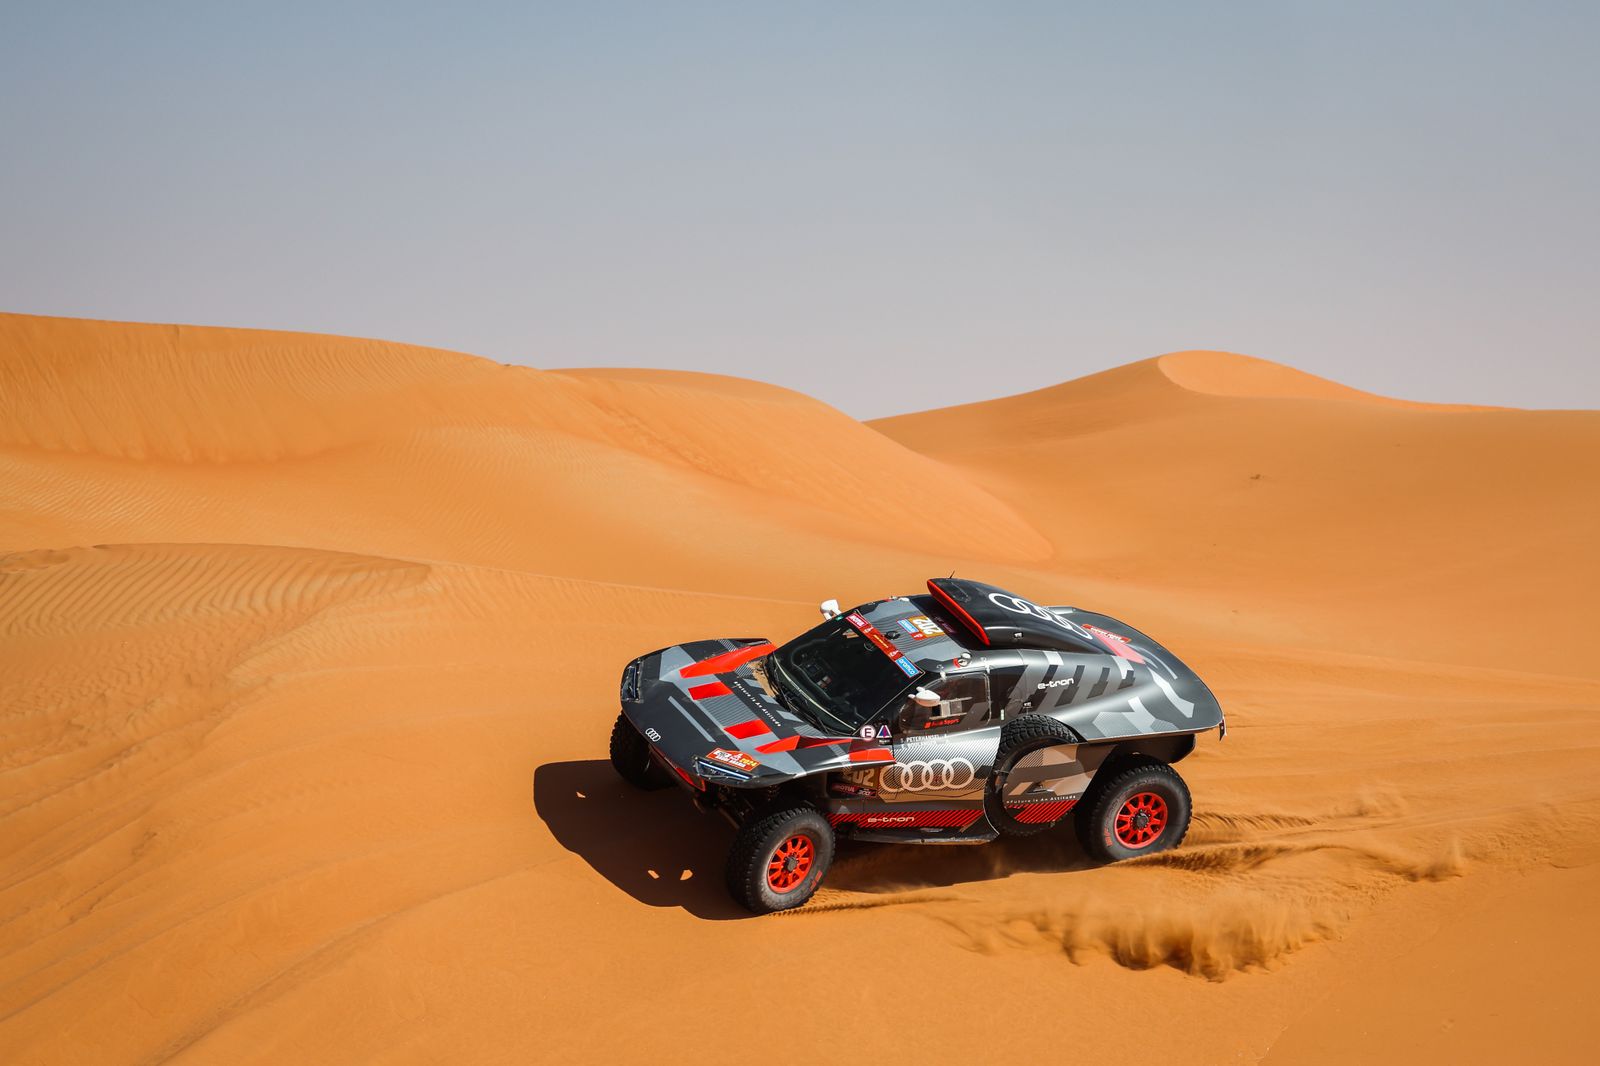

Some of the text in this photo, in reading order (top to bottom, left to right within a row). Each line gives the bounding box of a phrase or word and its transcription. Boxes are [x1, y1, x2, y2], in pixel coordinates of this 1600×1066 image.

[1037, 677, 1074, 690] e-tron
[864, 727, 872, 739] E
[833, 784, 855, 793] OTUL
